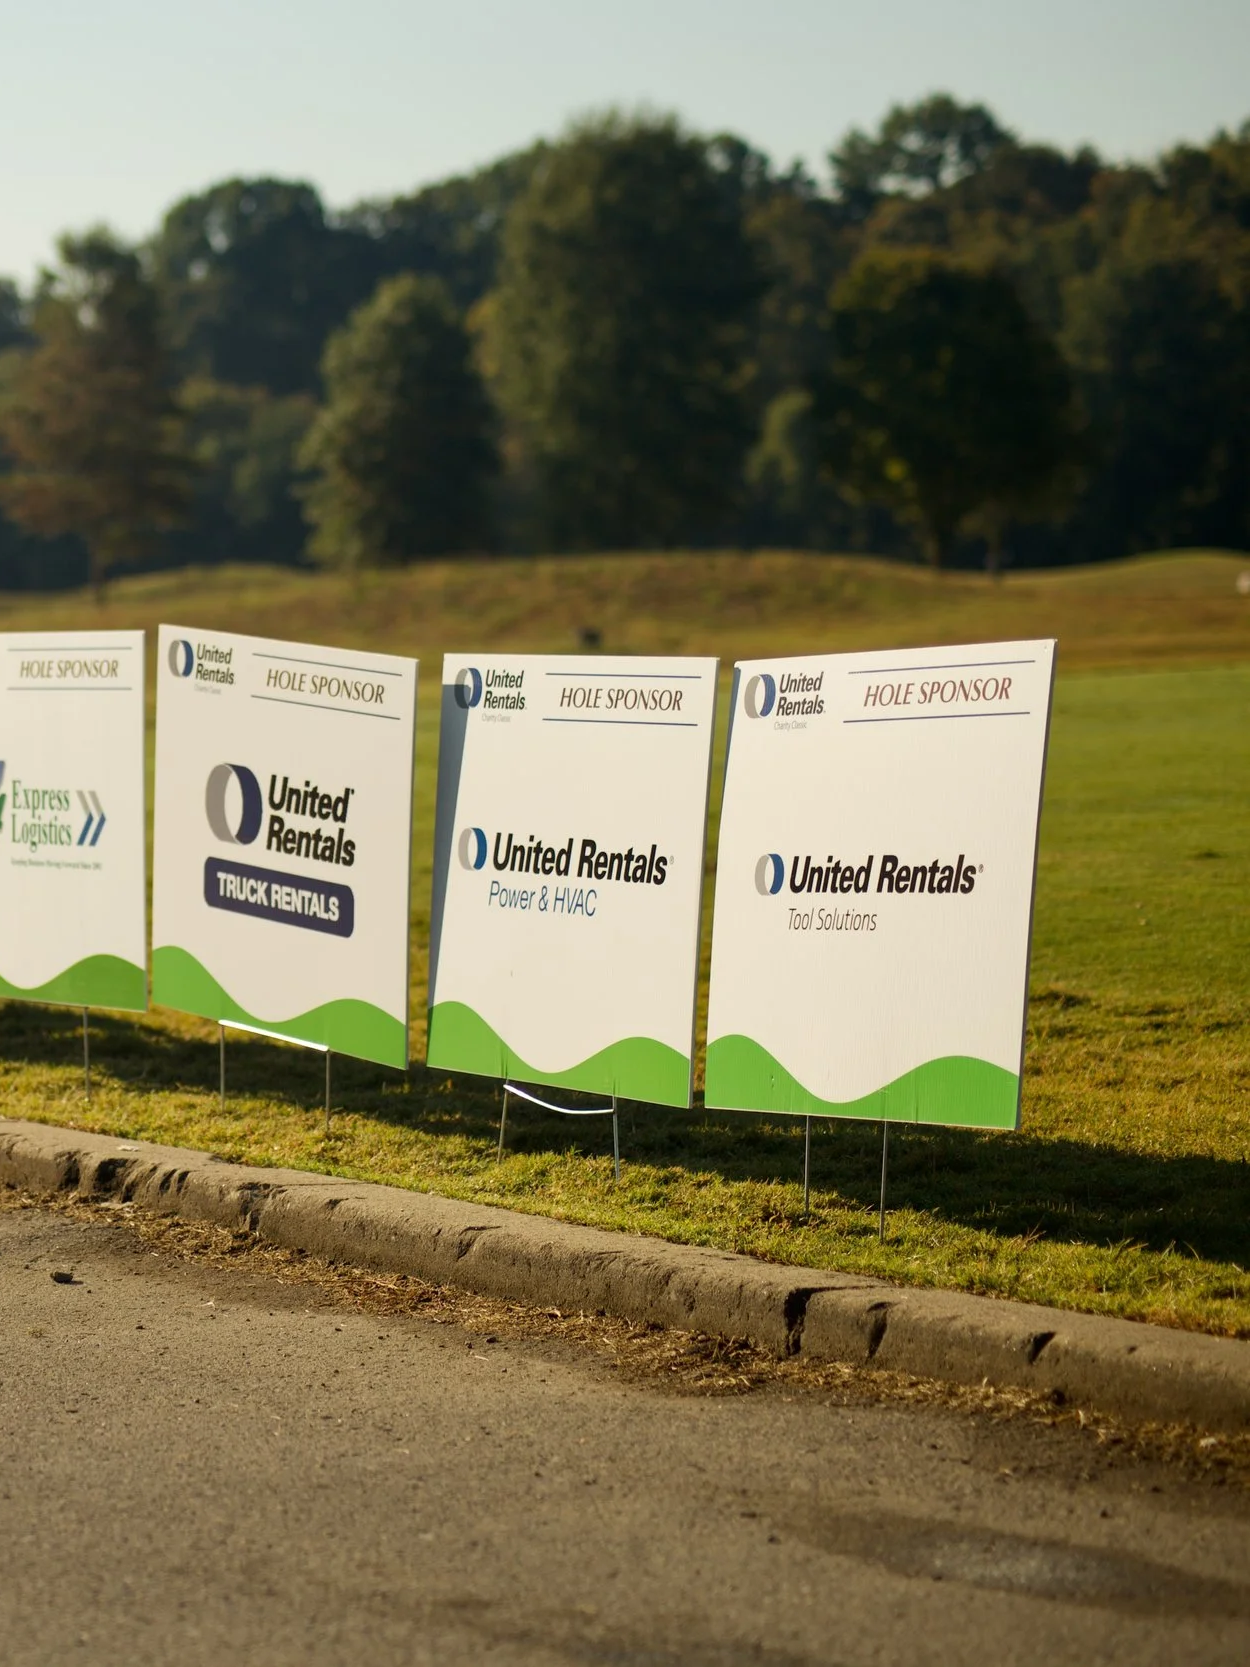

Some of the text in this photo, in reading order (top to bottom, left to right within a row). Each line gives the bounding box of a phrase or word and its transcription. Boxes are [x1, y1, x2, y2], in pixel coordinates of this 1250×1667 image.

[196, 643, 233, 664] United
[19, 659, 119, 679] HOLE SPONSOR
[195, 662, 235, 685] Rentals
[485, 669, 524, 688] United
[779, 671, 824, 693] United
[266, 668, 385, 704] HOLE SPONSOR
[483, 690, 526, 710] Rentals
[559, 687, 683, 711] HOLE SPONSOR
[863, 677, 1013, 707] HOLE SPONSOR
[776, 694, 825, 716] Rentals
[12, 779, 70, 818] Express
[268, 774, 351, 823] United
[12, 813, 72, 853] Logistics
[266, 814, 356, 867] Rentals
[493, 832, 573, 877] United
[789, 855, 874, 893] United
[217, 871, 340, 922] TRUCK RENTALS
[488, 880, 598, 917] Power & HVAC
[788, 908, 878, 931] Tool Solutions
